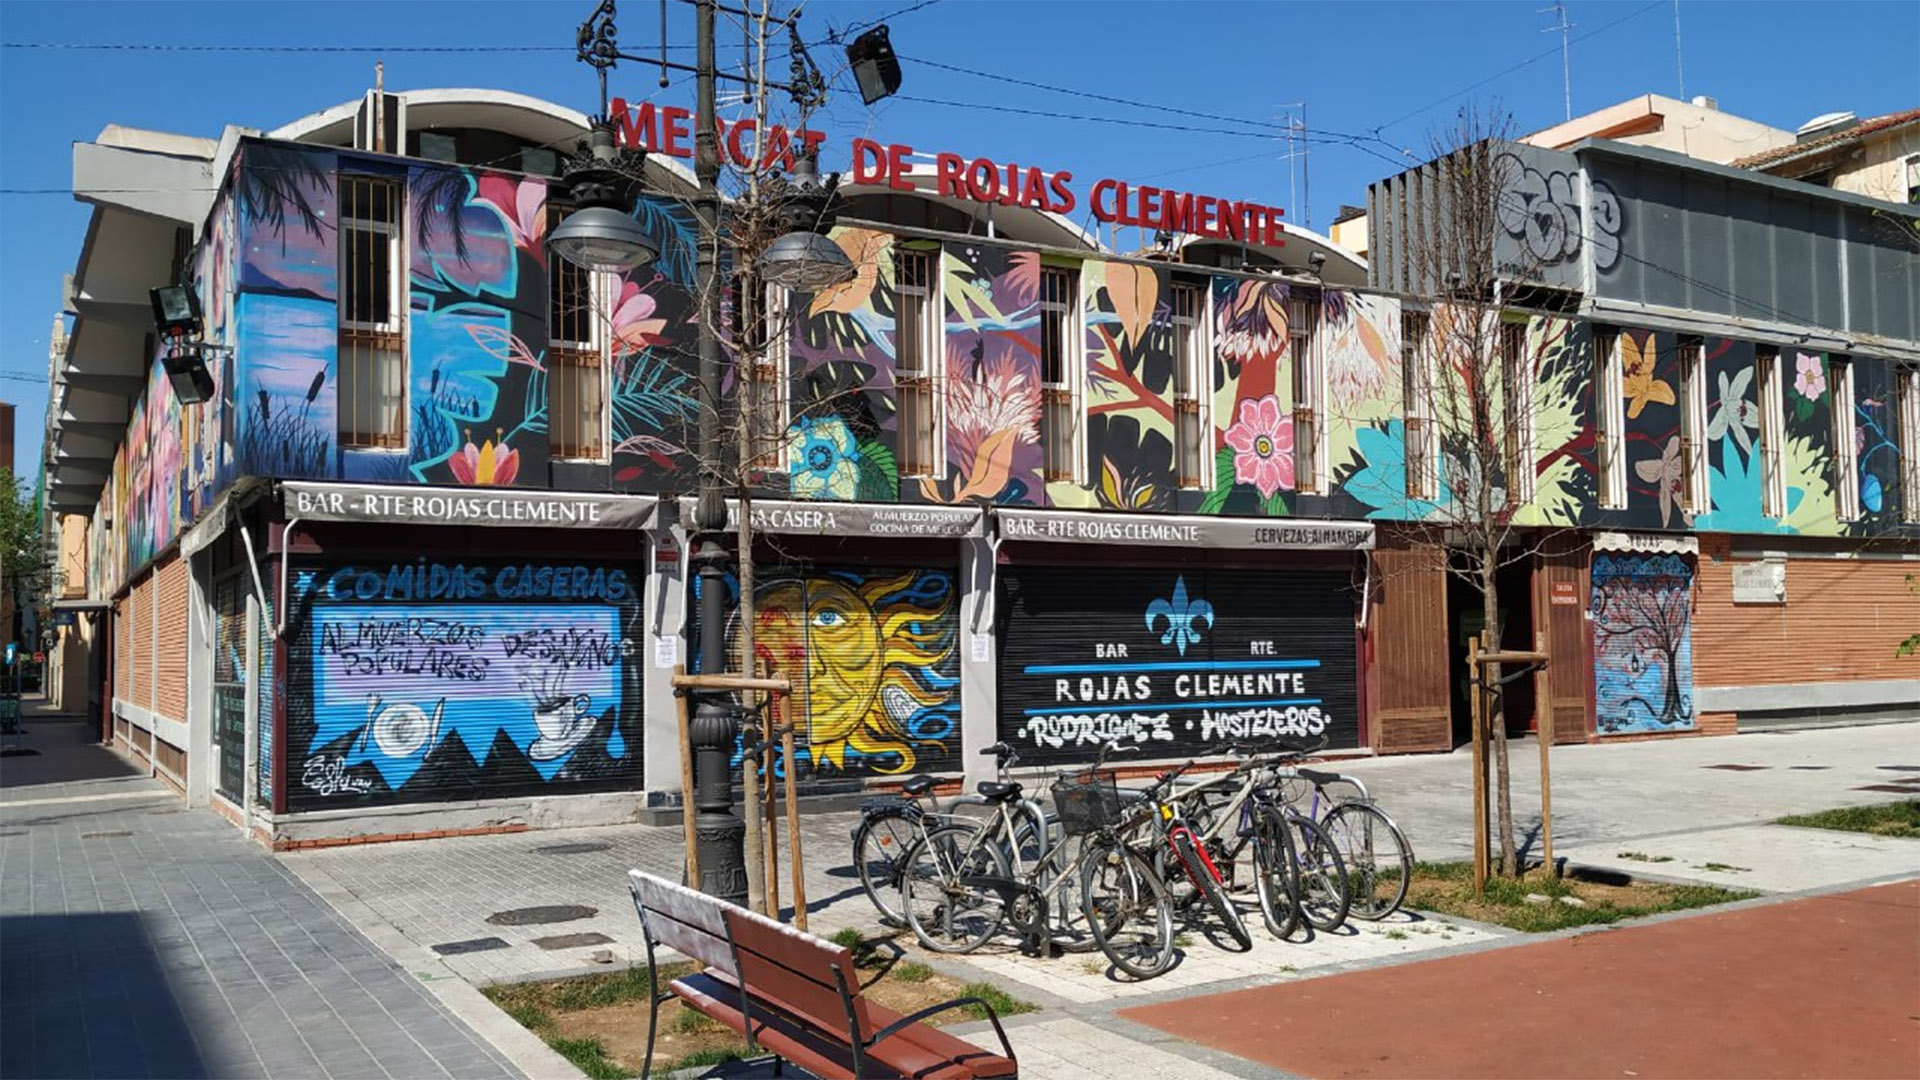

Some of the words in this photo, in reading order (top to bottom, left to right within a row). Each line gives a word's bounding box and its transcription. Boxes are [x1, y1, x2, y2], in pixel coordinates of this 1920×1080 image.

[852, 137, 916, 191] DE
[936, 152, 1077, 215] ROJAS
[1090, 178, 1286, 248] CLEMENTE
[297, 492, 345, 514] BAR
[364, 494, 407, 516] RTE
[412, 496, 481, 519] ROJAS
[486, 499, 600, 522] CLEMENTE
[771, 509, 836, 528] CASERA
[872, 511, 929, 522] ALMUERZO
[930, 512, 975, 523] POPULAR
[869, 523, 910, 534] COCINA
[911, 524, 925, 534] DE
[1006, 518, 1036, 535] BAR
[1047, 519, 1075, 537] RTE
[1078, 521, 1122, 539] ROJAS
[1124, 523, 1200, 541] CLEMENTE
[1254, 528, 1309, 544] CERVEZAS
[1311, 529, 1369, 545] ALHAMBRA
[325, 557, 488, 600] COMIDAS
[493, 564, 627, 599] CASERAS
[319, 616, 486, 656] ALMUERZOS
[1250, 640, 1278, 656] RTE.
[1095, 643, 1129, 658] BAR
[340, 648, 490, 681] POPULARES
[1056, 675, 1151, 702] ROJAS
[1175, 672, 1306, 698] CLEMENTE
[1027, 712, 1175, 748] RODRIGUEZ
[1201, 706, 1325, 742] HOSTELEROS
